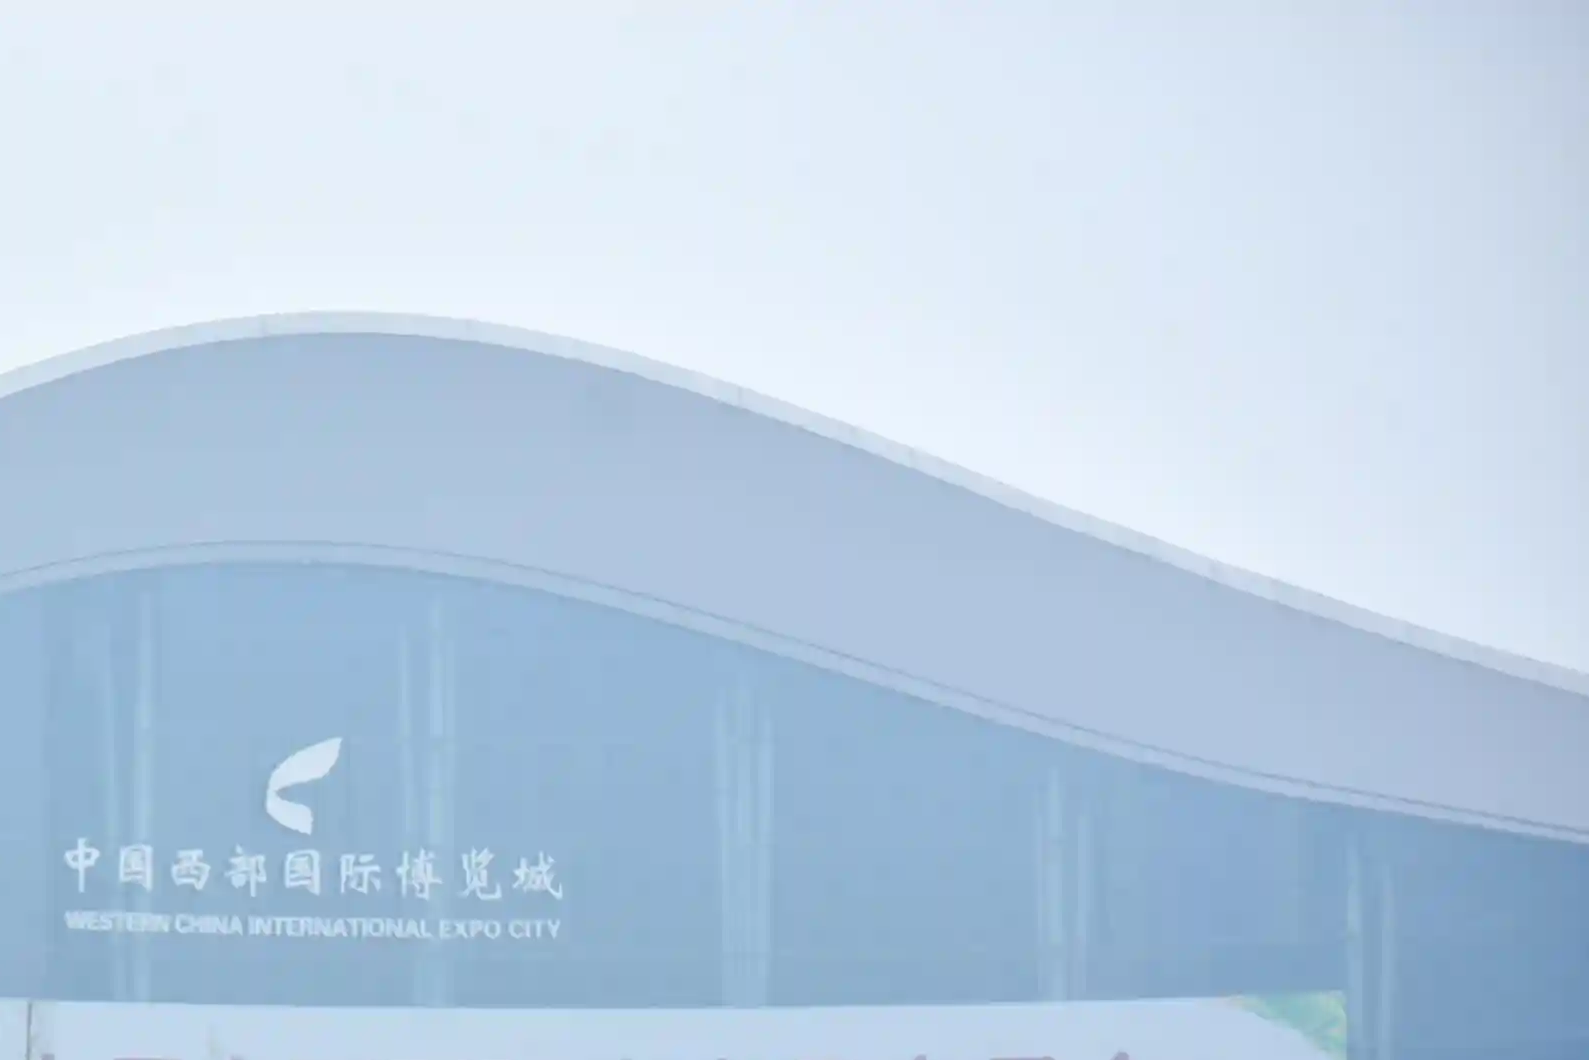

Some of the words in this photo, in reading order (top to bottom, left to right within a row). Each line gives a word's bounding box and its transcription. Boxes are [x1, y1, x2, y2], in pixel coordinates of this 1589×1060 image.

[64, 837, 563, 900] 中国西部国际博览城
[64, 910, 170, 933] WESTERN
[174, 914, 243, 936] CHINA
[248, 915, 433, 939] INTERNATIONAL
[439, 919, 501, 939] EXPO
[508, 919, 561, 940] CITY
